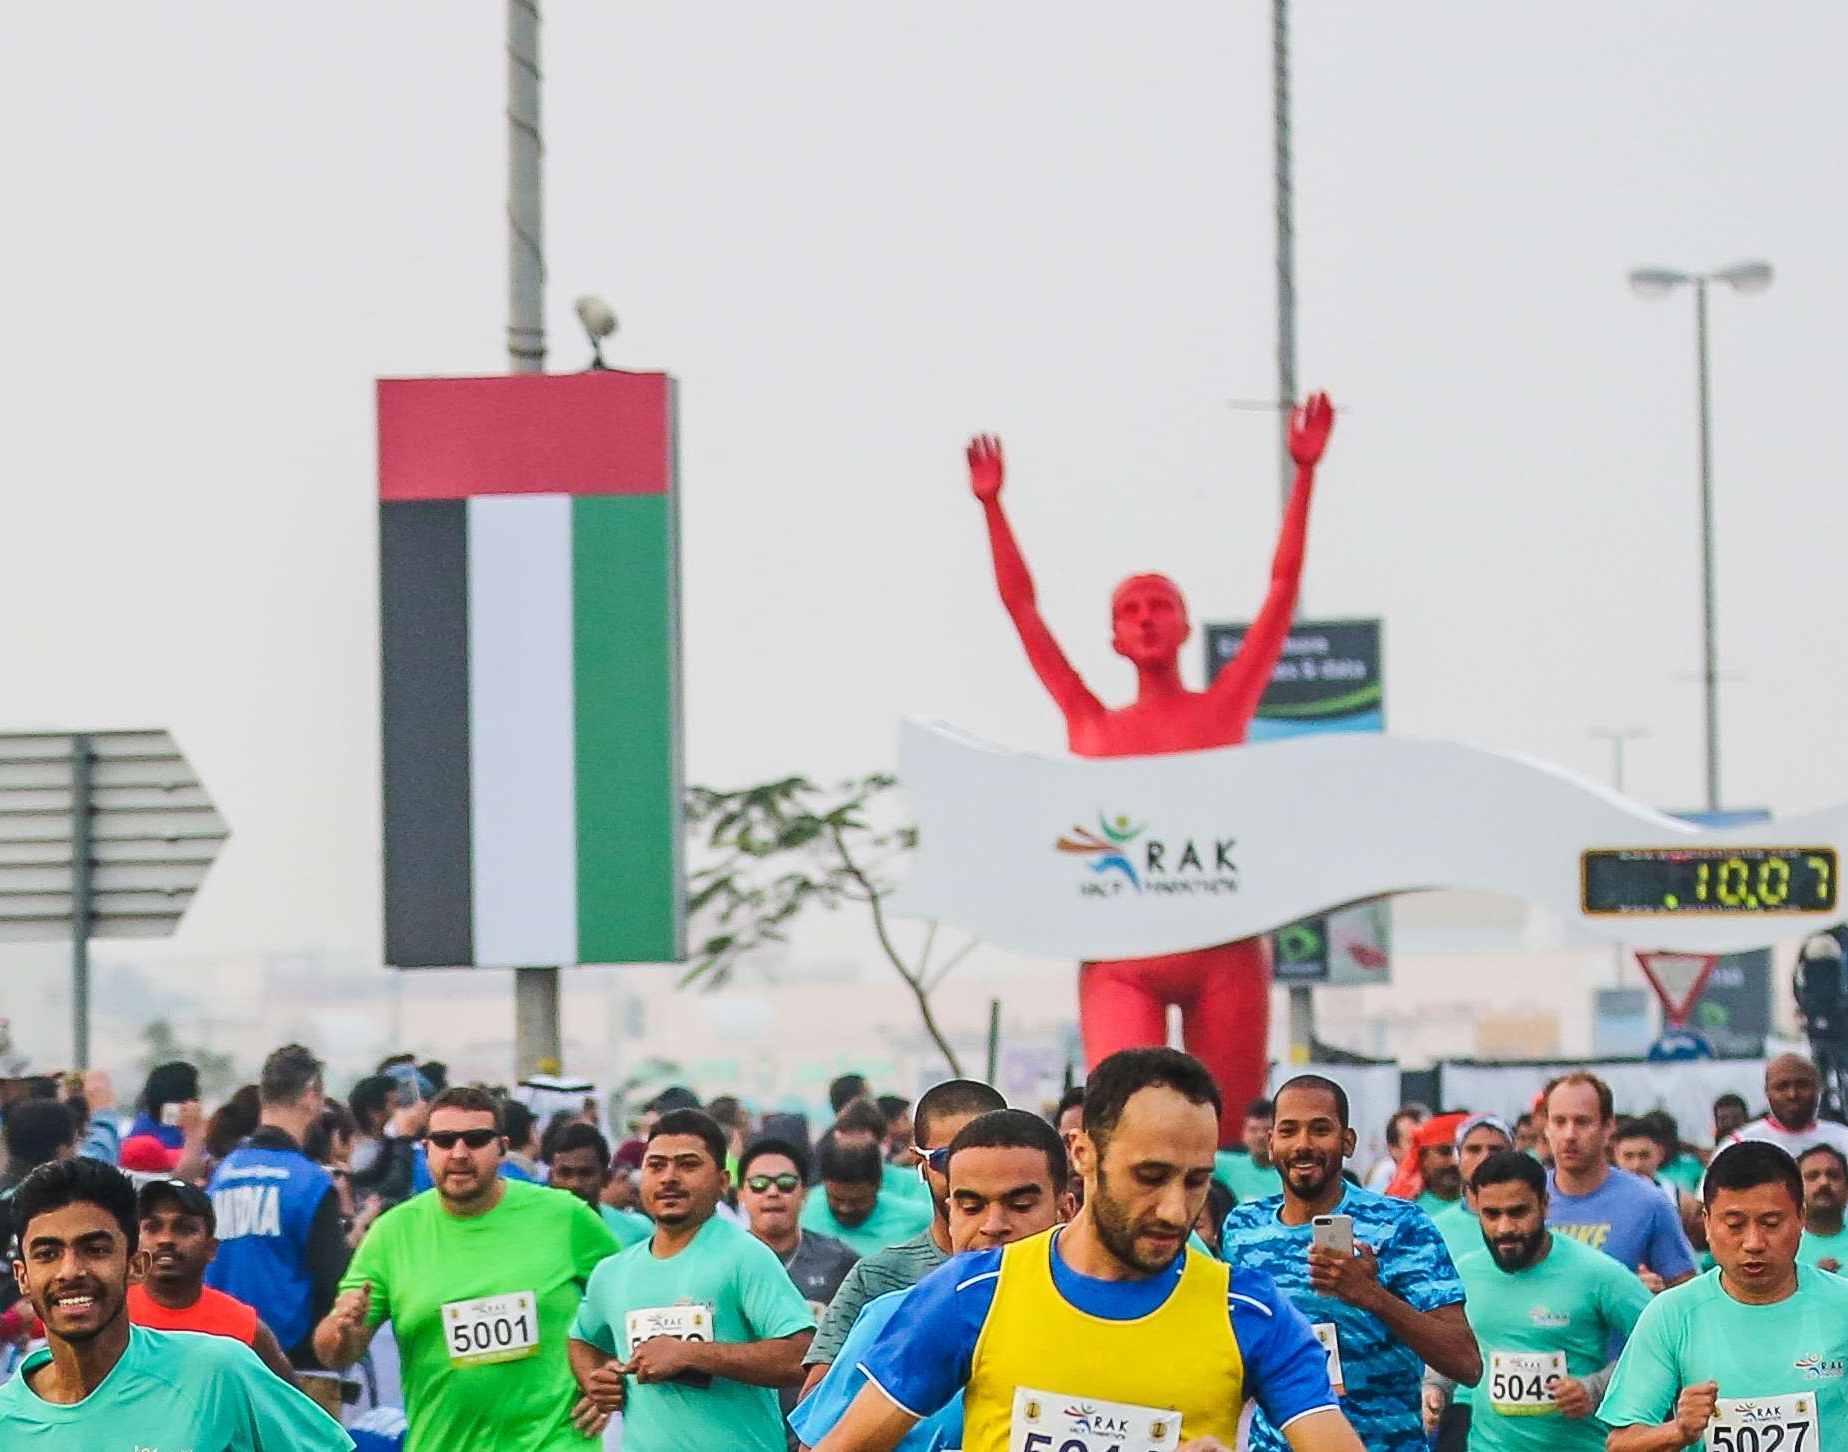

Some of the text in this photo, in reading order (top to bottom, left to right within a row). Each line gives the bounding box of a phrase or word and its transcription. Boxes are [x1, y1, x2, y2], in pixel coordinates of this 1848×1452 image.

[1146, 839, 1238, 872] RAK
[454, 1315, 528, 1352] 5001
[1094, 1415, 1128, 1432] RAK
[1757, 1406, 1782, 1417] RAK
